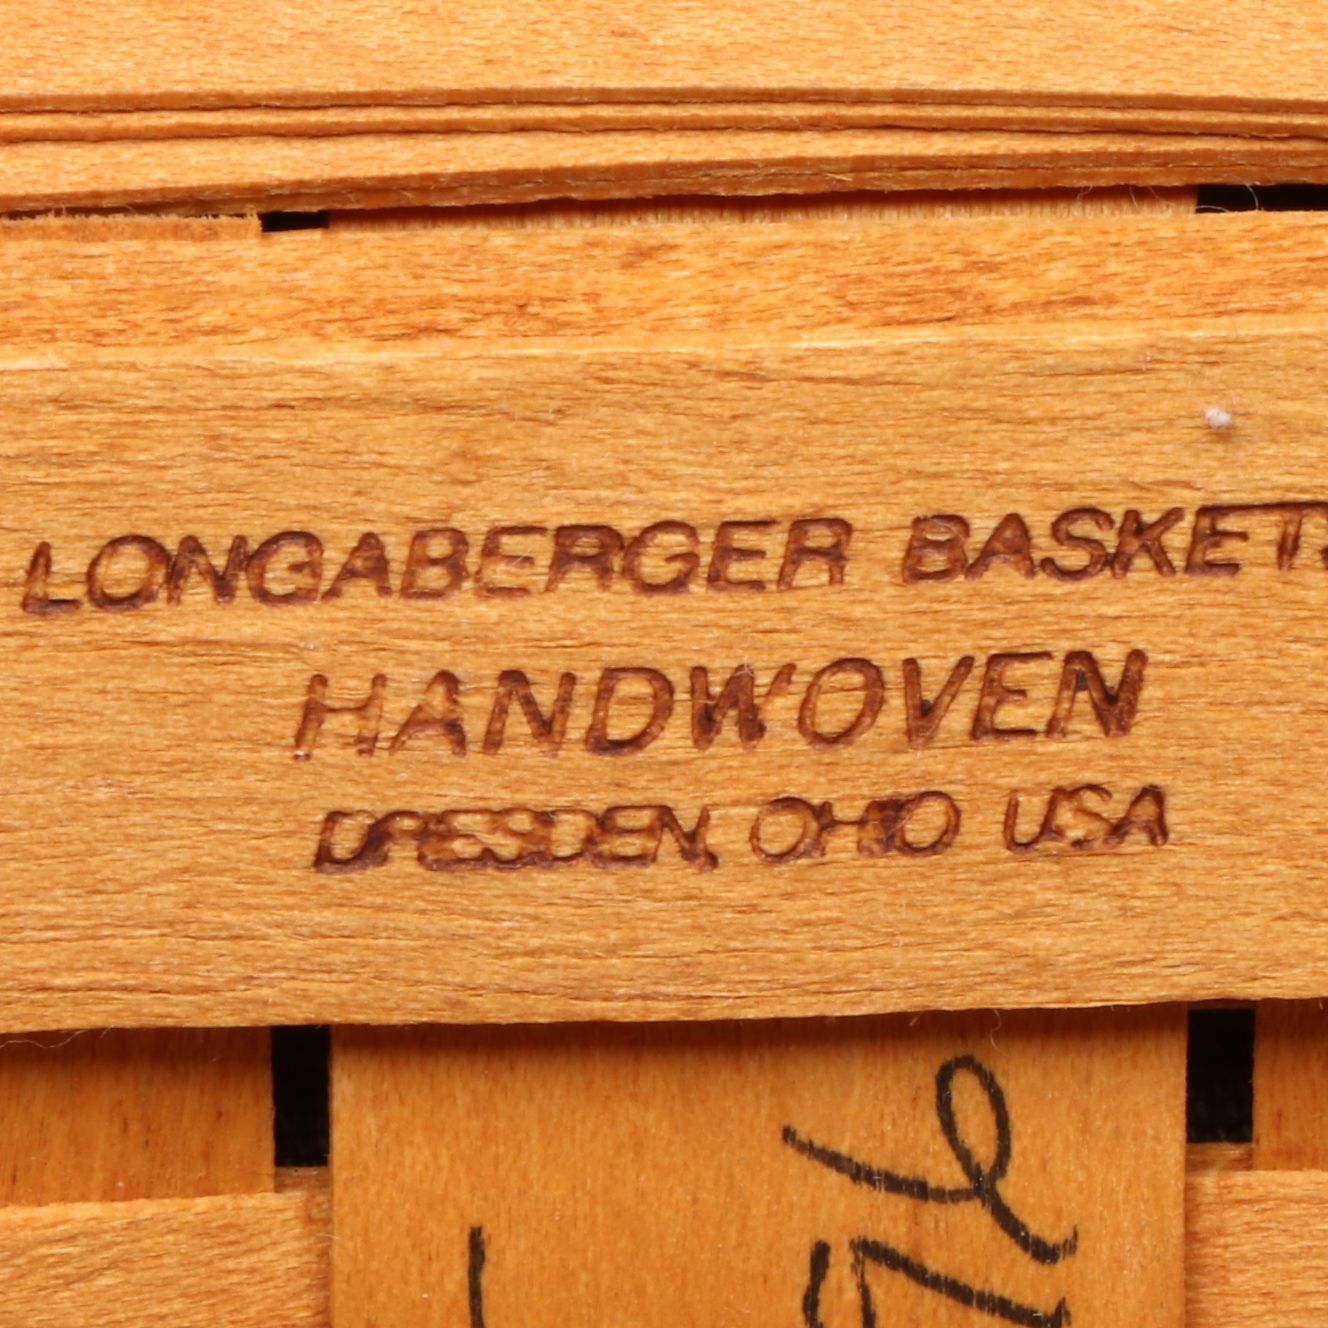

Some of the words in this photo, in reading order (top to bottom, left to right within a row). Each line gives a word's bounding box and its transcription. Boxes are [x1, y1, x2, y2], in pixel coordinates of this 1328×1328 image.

[20, 515, 853, 611] LONGABERGER
[291, 648, 1150, 762] HANDWOVEN
[1002, 783, 1169, 853] USA
